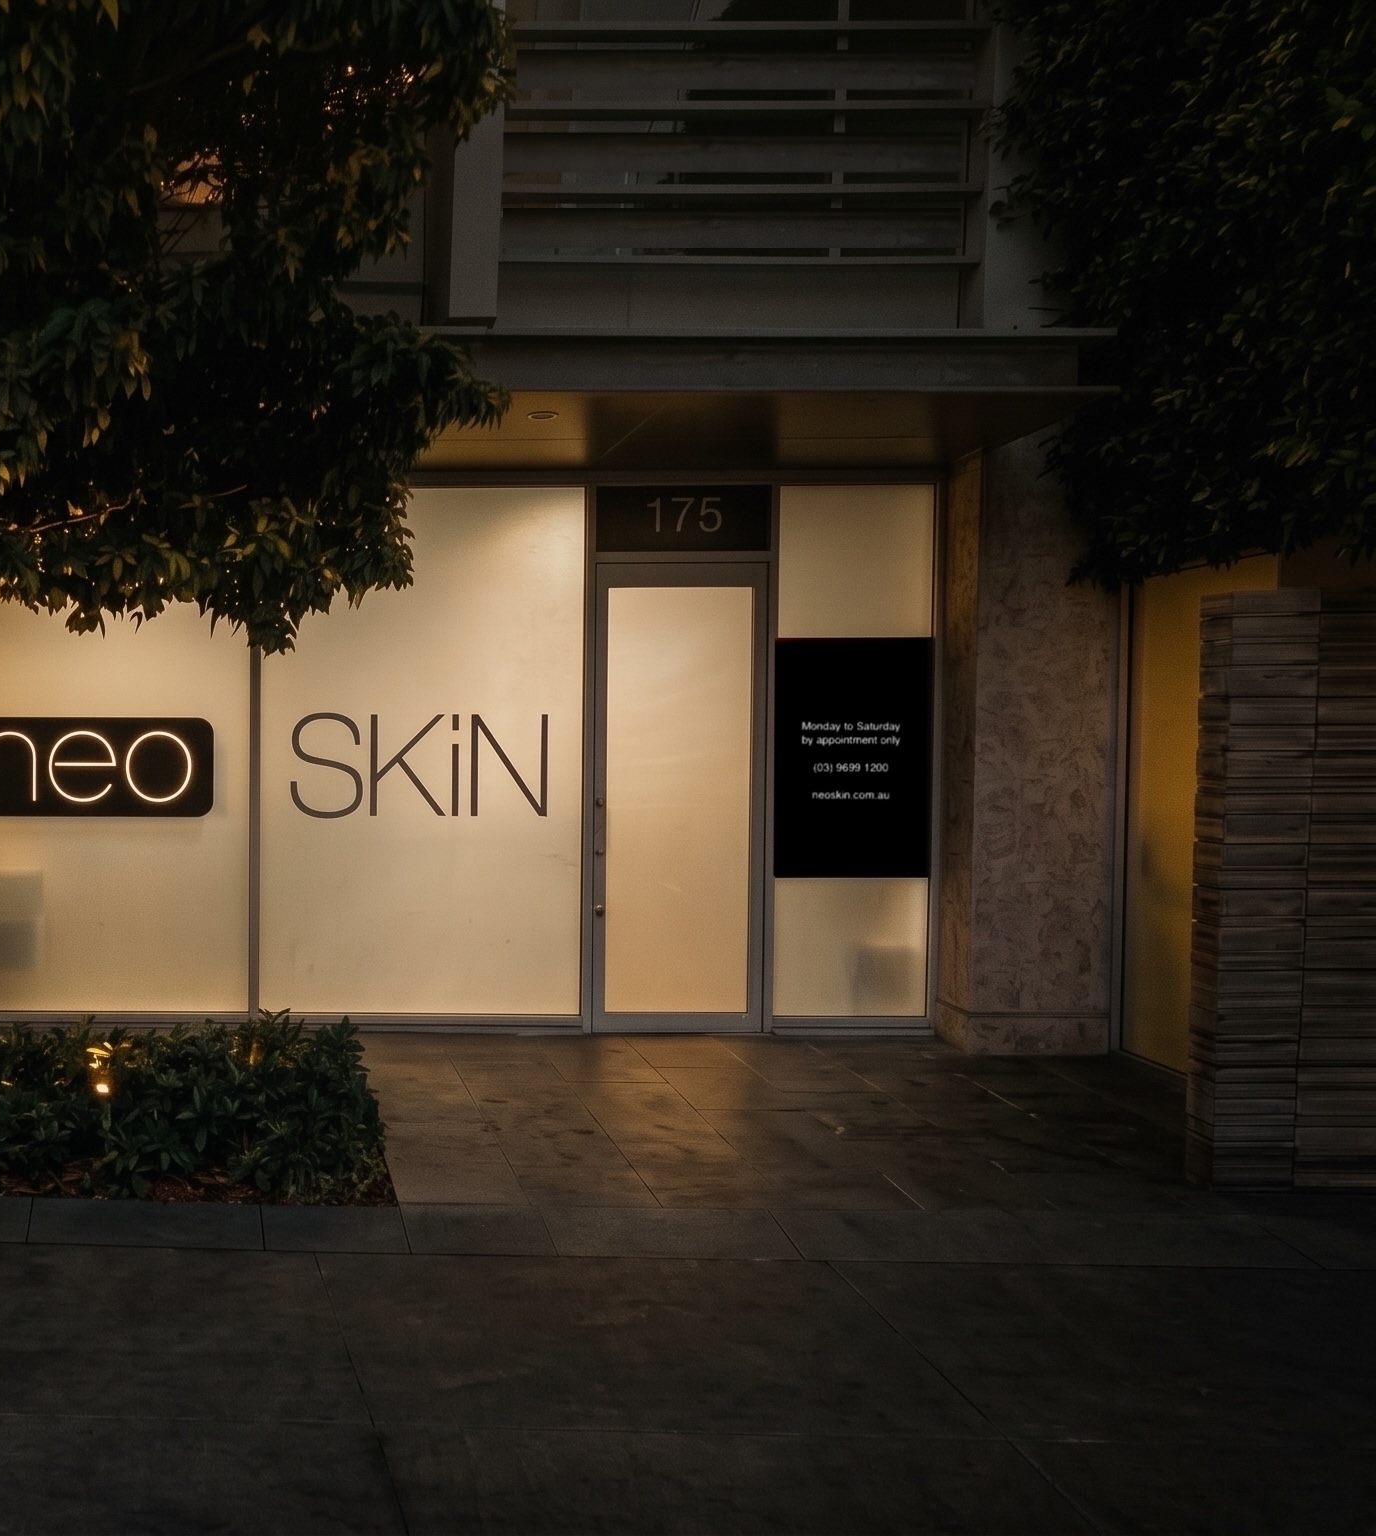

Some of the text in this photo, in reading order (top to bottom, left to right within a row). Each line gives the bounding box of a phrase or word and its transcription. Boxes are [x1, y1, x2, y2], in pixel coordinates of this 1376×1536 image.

[646, 496, 723, 533] 175
[801, 721, 901, 733] Monday to Saturday
[801, 735, 901, 747] by appointment only
[812, 762, 889, 774] (03) 9699 1200
[811, 790, 891, 800] neoskin.com.au
